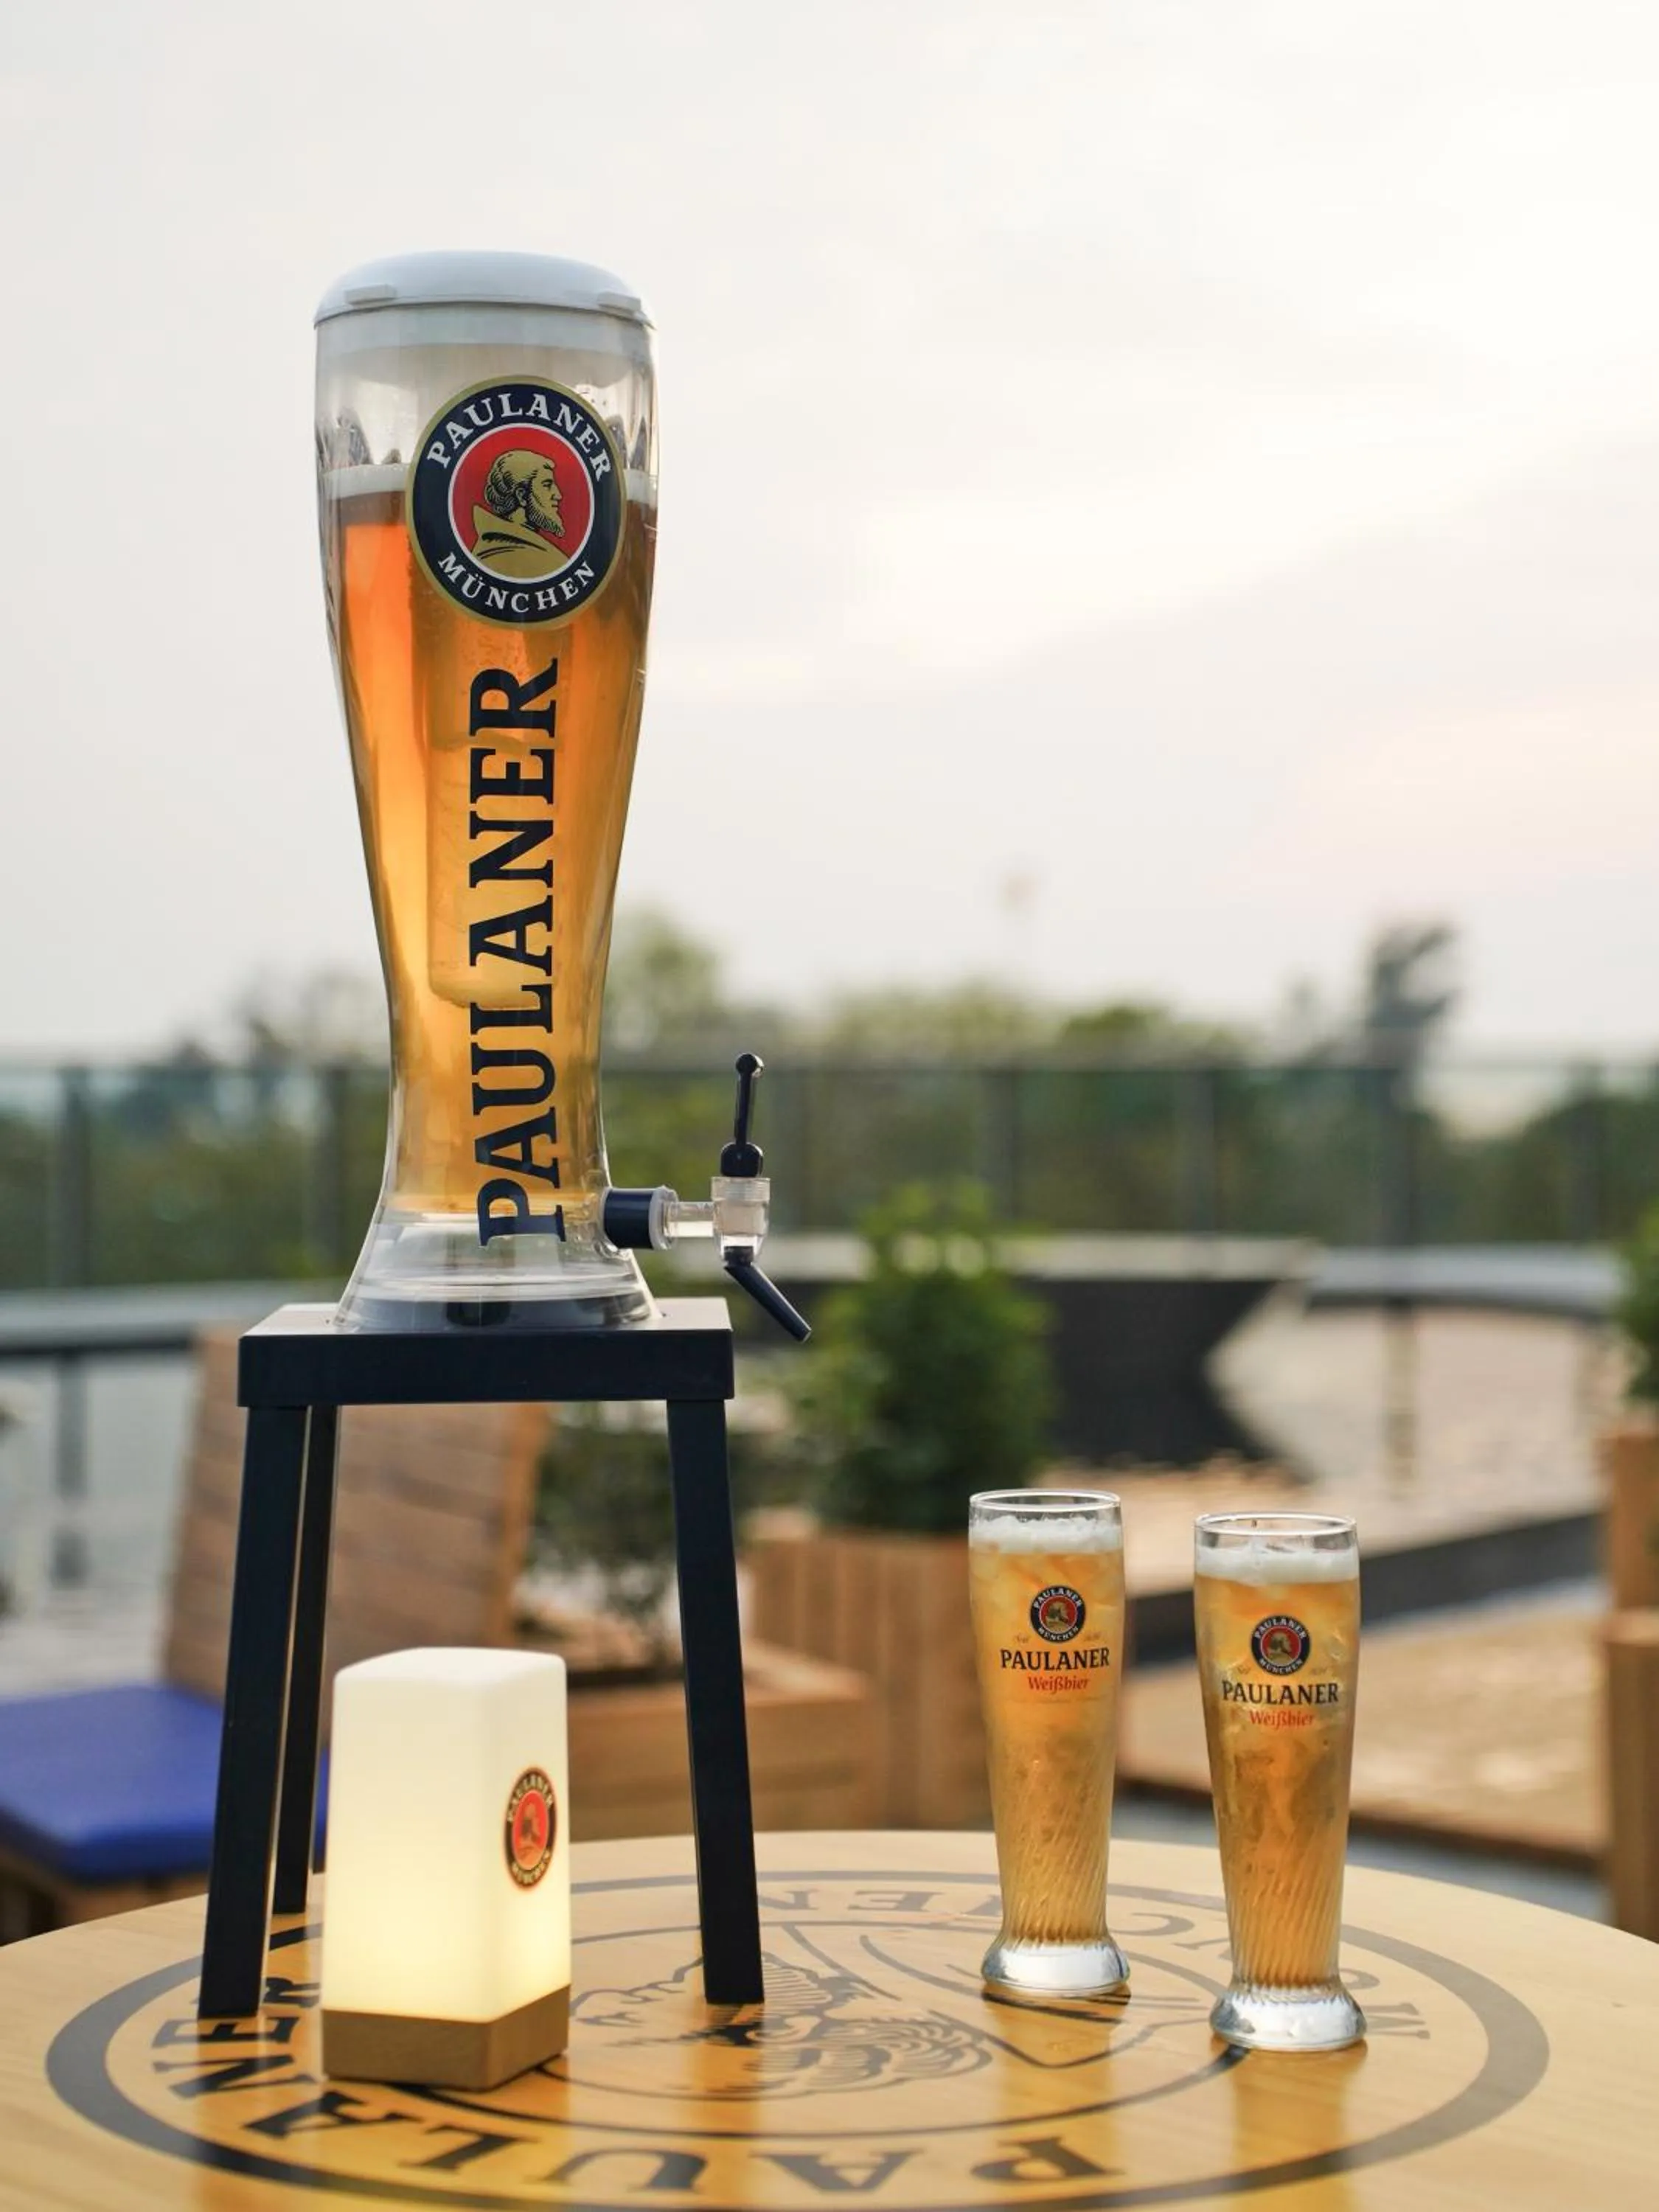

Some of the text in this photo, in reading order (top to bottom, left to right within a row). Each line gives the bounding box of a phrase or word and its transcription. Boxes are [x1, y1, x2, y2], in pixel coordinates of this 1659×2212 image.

[427, 392, 612, 481] PAULANER
[437, 552, 596, 613] MÜNCHEN
[468, 657, 566, 1248] PAULANER
[1033, 1587, 1082, 1608] PAULANER
[1253, 1618, 1307, 1639] PAULANER
[1000, 1646, 1110, 1671] PAULANER
[1028, 1674, 1091, 1695] Weißbier
[1221, 1679, 1340, 1705] PAULANER
[1249, 1709, 1315, 1730] Weißbier
